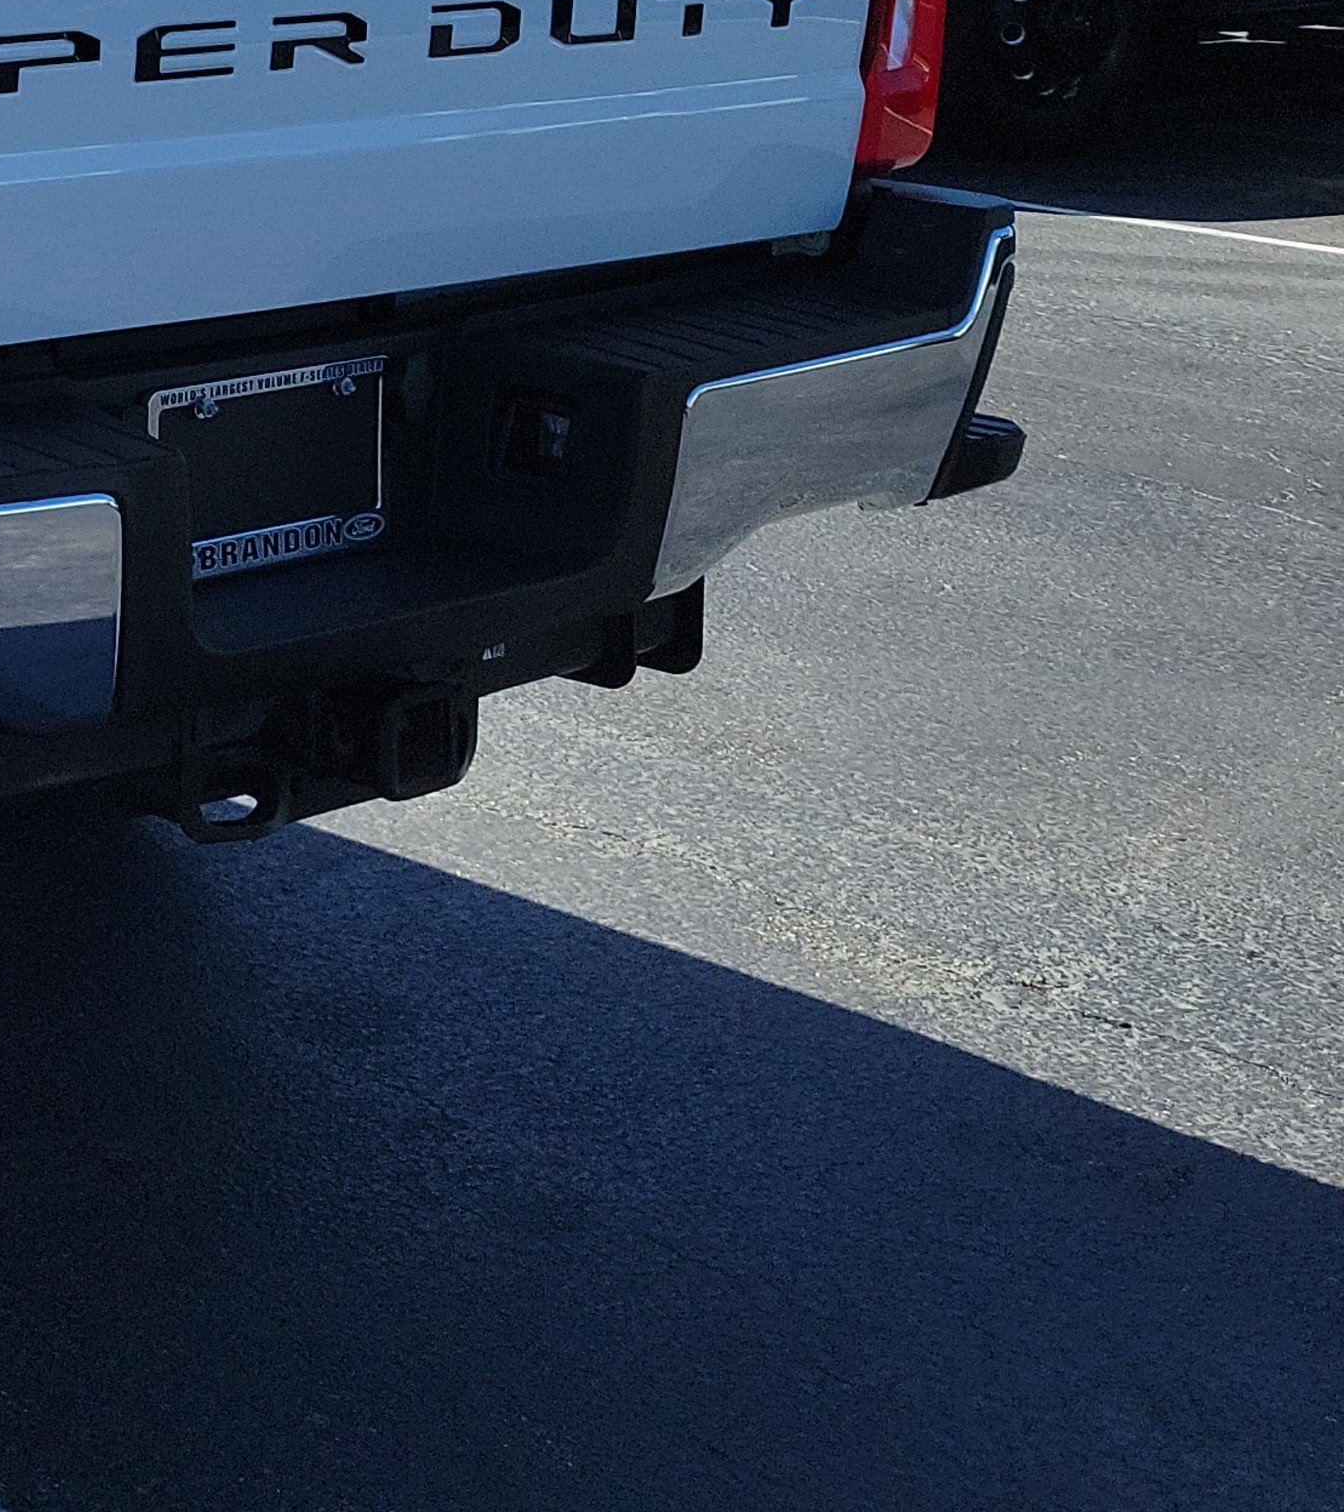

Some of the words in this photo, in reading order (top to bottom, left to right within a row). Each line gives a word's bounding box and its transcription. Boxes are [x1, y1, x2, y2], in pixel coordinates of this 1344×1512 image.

[210, 381, 254, 398] LARGEST
[257, 373, 298, 390] VOLUME
[197, 518, 342, 571] BRANDON
